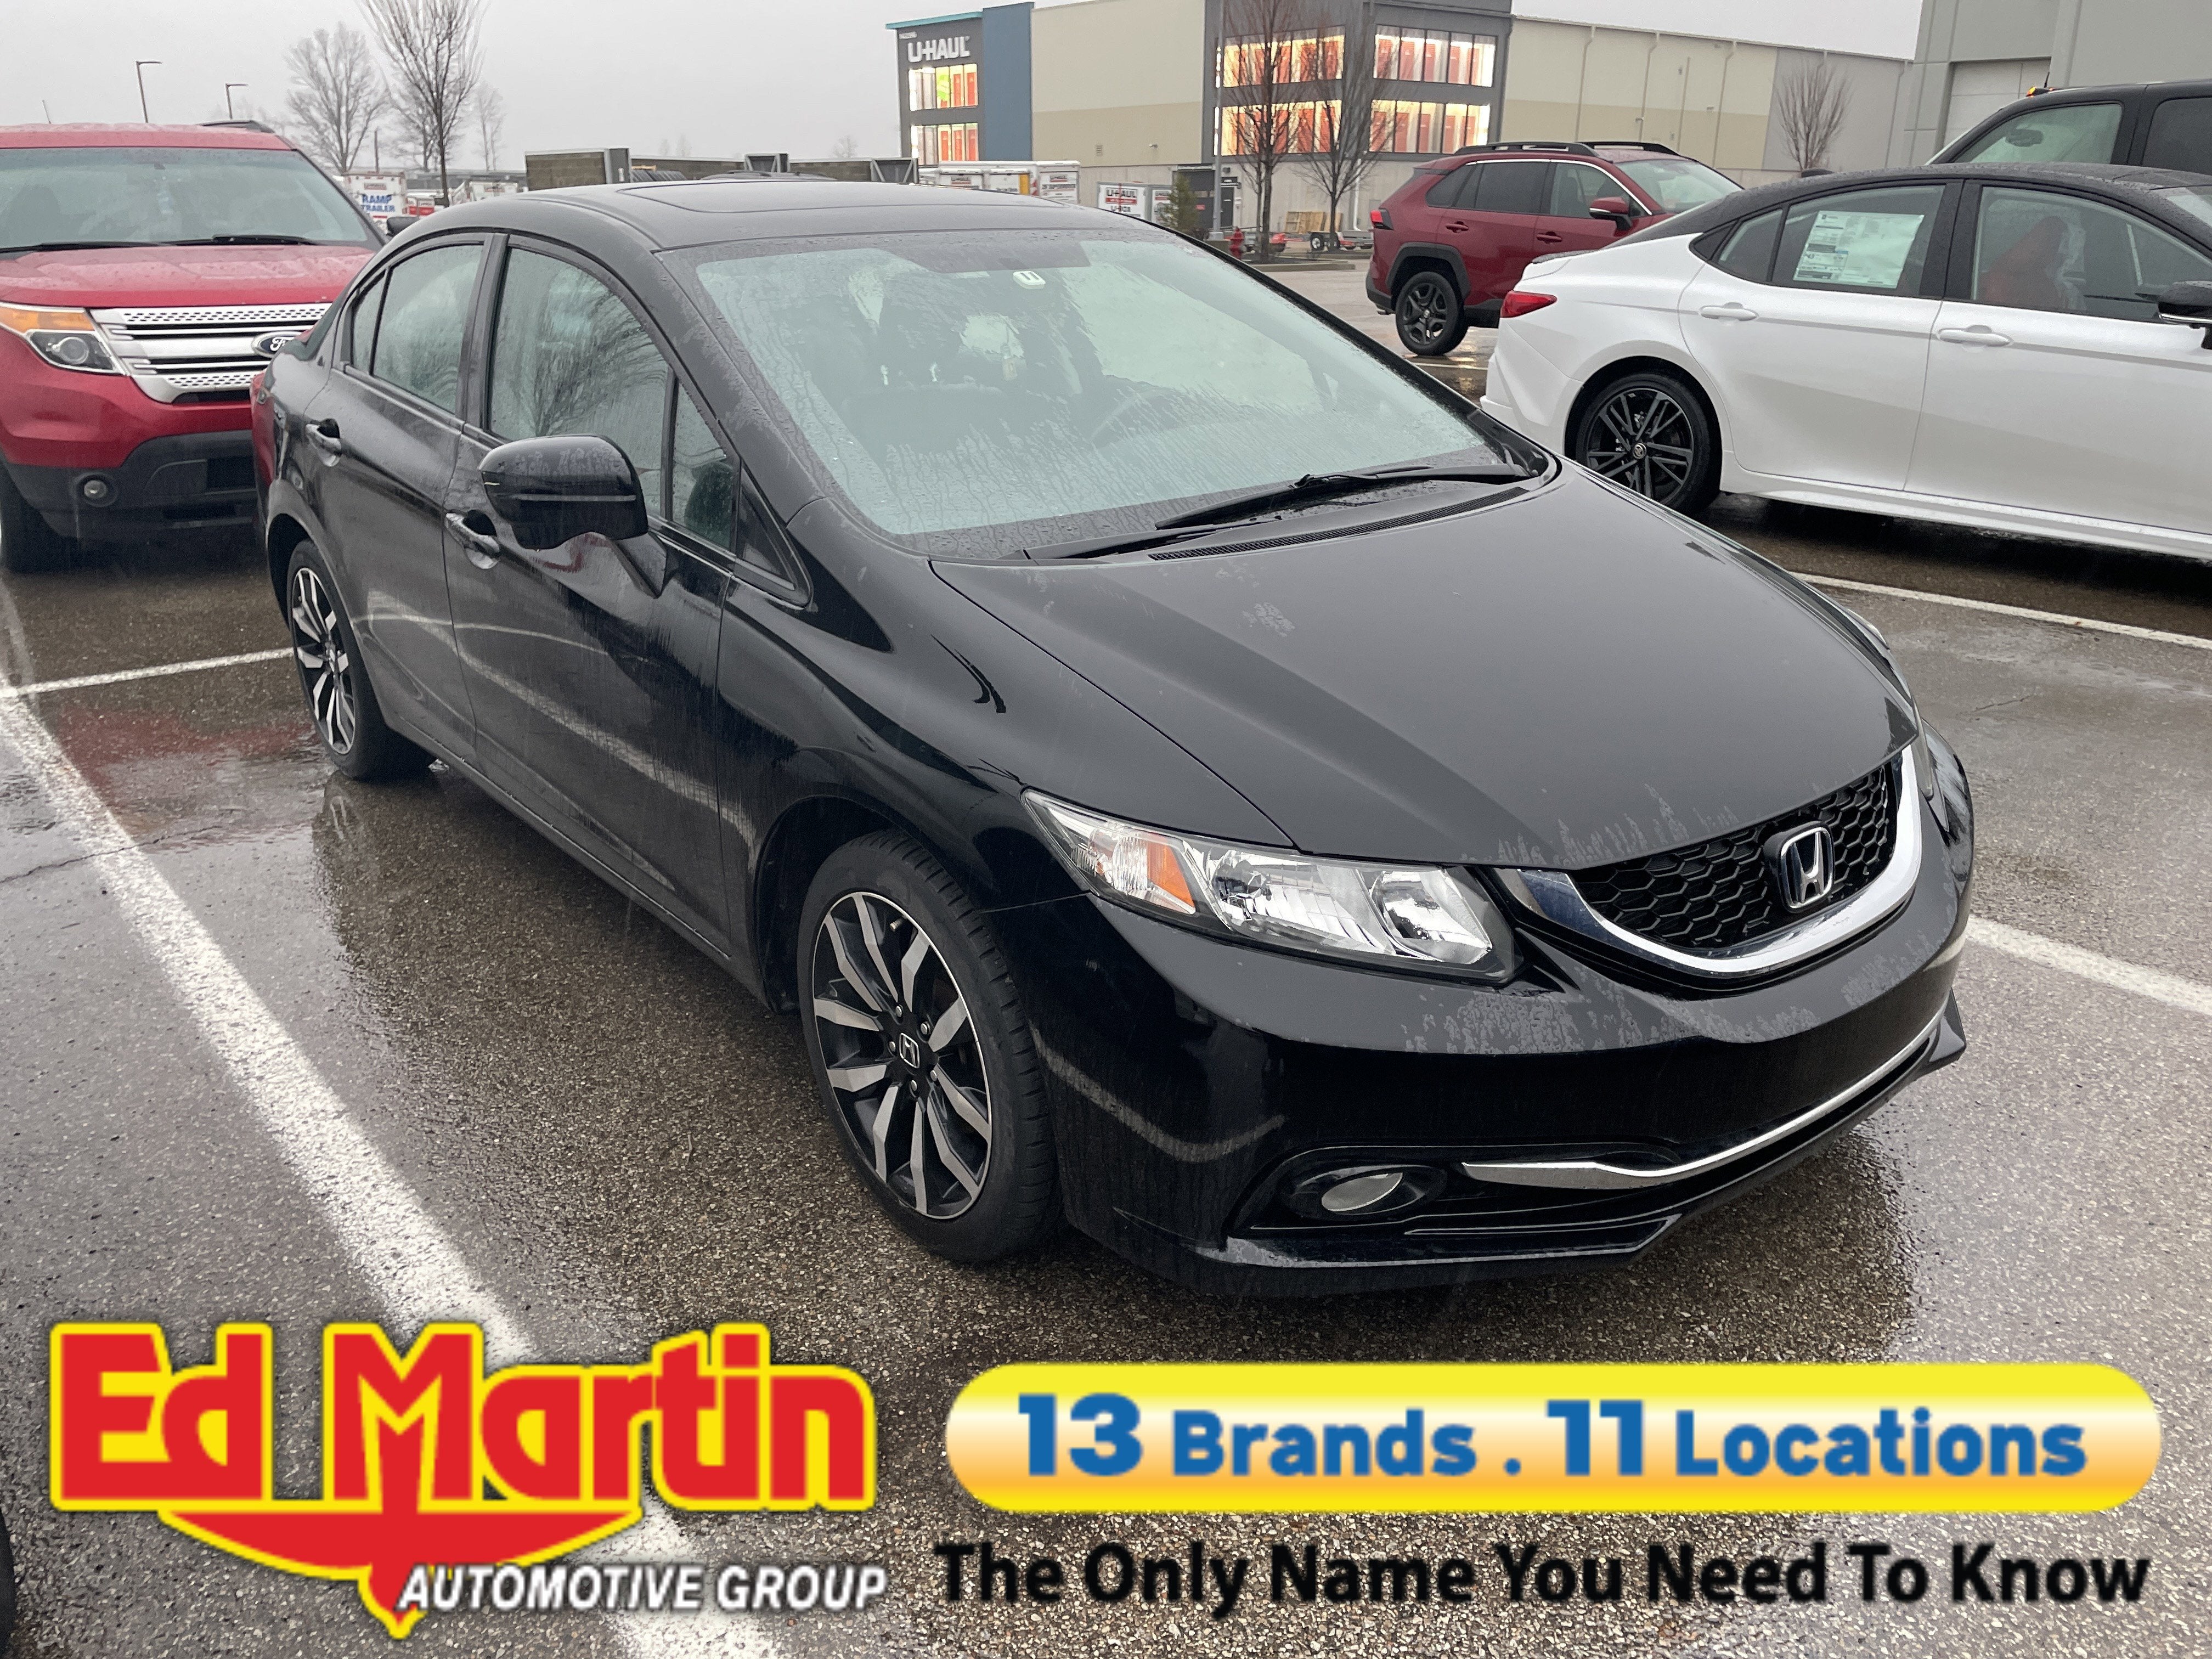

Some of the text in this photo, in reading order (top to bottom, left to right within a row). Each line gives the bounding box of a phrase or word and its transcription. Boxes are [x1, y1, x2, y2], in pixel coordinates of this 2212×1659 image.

[907, 36, 970, 63] U-HAUL
[362, 194, 392, 204] RAMP
[360, 204, 396, 212] TRAILER
